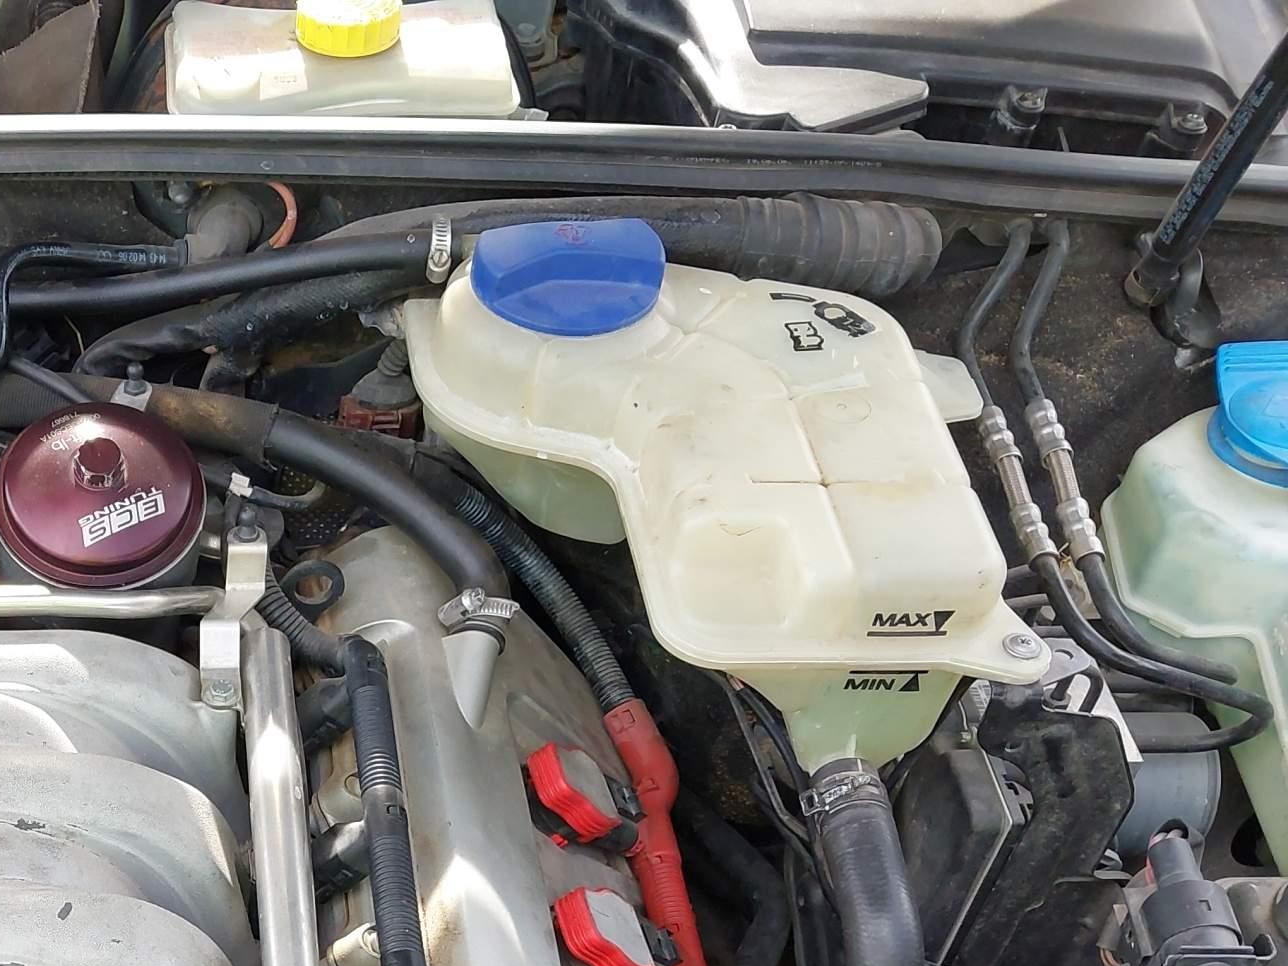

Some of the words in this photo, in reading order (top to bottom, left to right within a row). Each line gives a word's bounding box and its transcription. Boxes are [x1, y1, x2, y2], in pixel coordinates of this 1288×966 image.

[78, 486, 163, 528] TUNING
[81, 493, 165, 548] ECS
[871, 612, 932, 627] MAX
[843, 678, 896, 690] MIN
